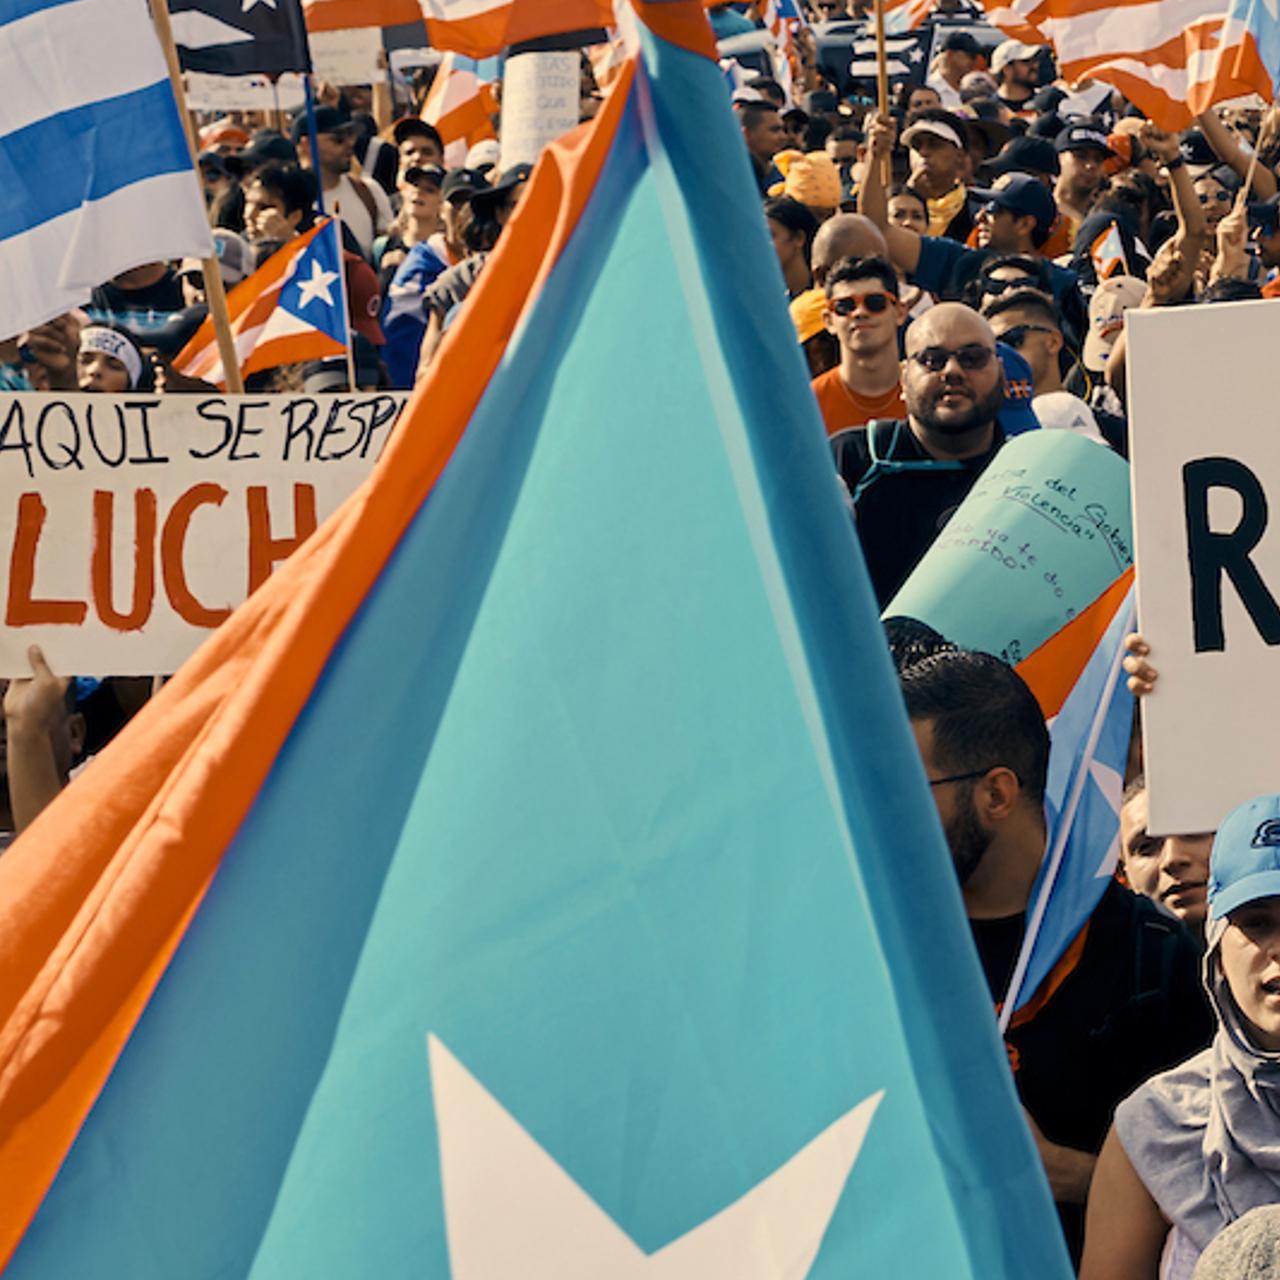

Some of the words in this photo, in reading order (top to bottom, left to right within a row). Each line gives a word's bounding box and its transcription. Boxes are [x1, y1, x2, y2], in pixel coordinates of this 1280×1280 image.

[0, 398, 170, 477] AQUI
[188, 399, 271, 460] SE
[280, 393, 411, 464] RESP
